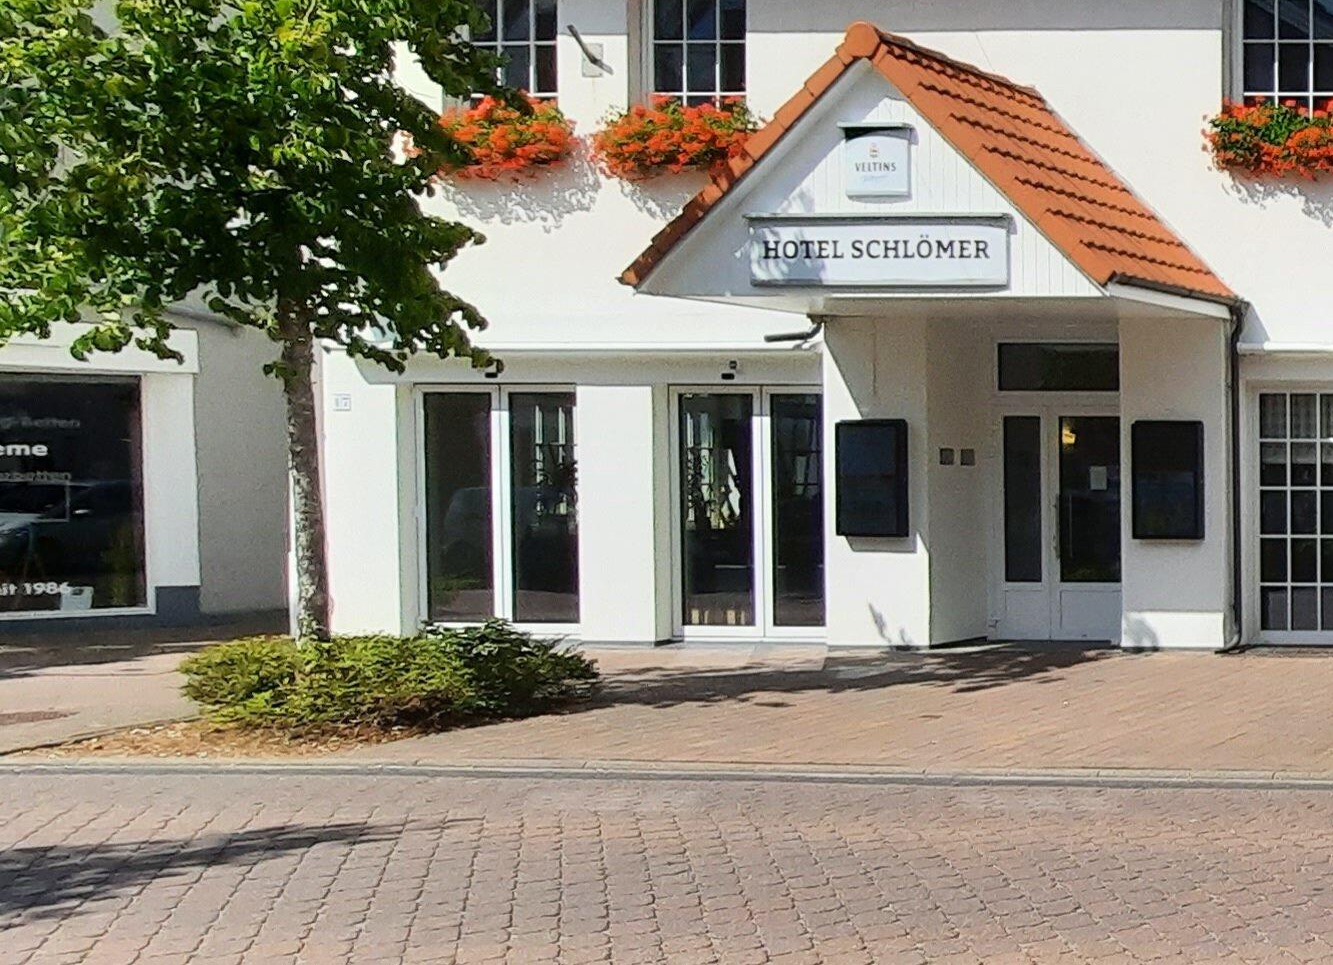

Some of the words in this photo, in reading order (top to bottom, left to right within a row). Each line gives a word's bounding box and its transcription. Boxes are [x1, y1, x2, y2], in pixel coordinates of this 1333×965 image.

[854, 161, 897, 173] VELTINS
[762, 239, 845, 260] HOTEL
[850, 234, 990, 260] SCHLÖMER
[23, 581, 71, 595] 1986
